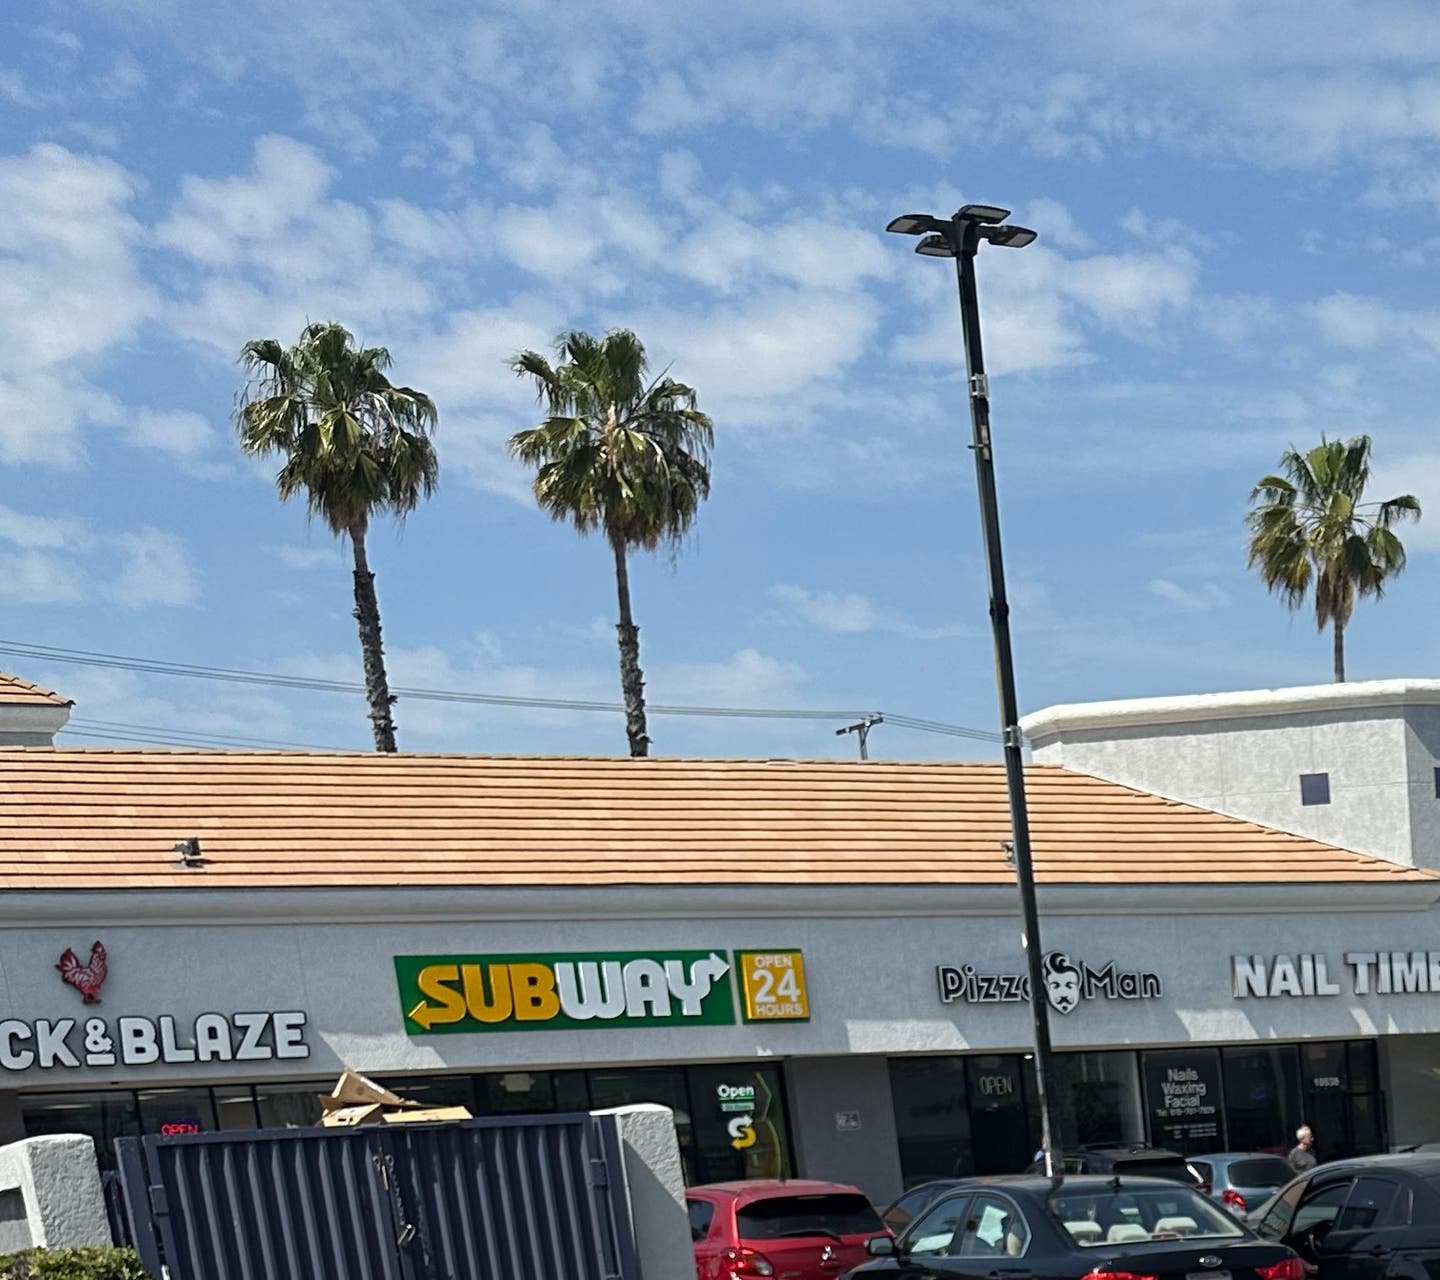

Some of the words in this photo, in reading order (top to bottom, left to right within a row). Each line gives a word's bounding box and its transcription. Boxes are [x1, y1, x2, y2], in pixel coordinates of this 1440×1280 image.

[755, 955, 792, 969] OPEN
[1081, 960, 1162, 999] Man
[1231, 952, 1340, 998] NAIL
[408, 953, 730, 1030] SUBWAY
[752, 968, 801, 1003] 24
[756, 1003, 803, 1016] HOURS
[1167, 1068, 1199, 1082] Nails
[717, 1084, 755, 1100] Open
[1161, 1082, 1207, 1096] Waxing
[1165, 1093, 1200, 1108] Facial
[161, 1123, 199, 1137] OPEN
